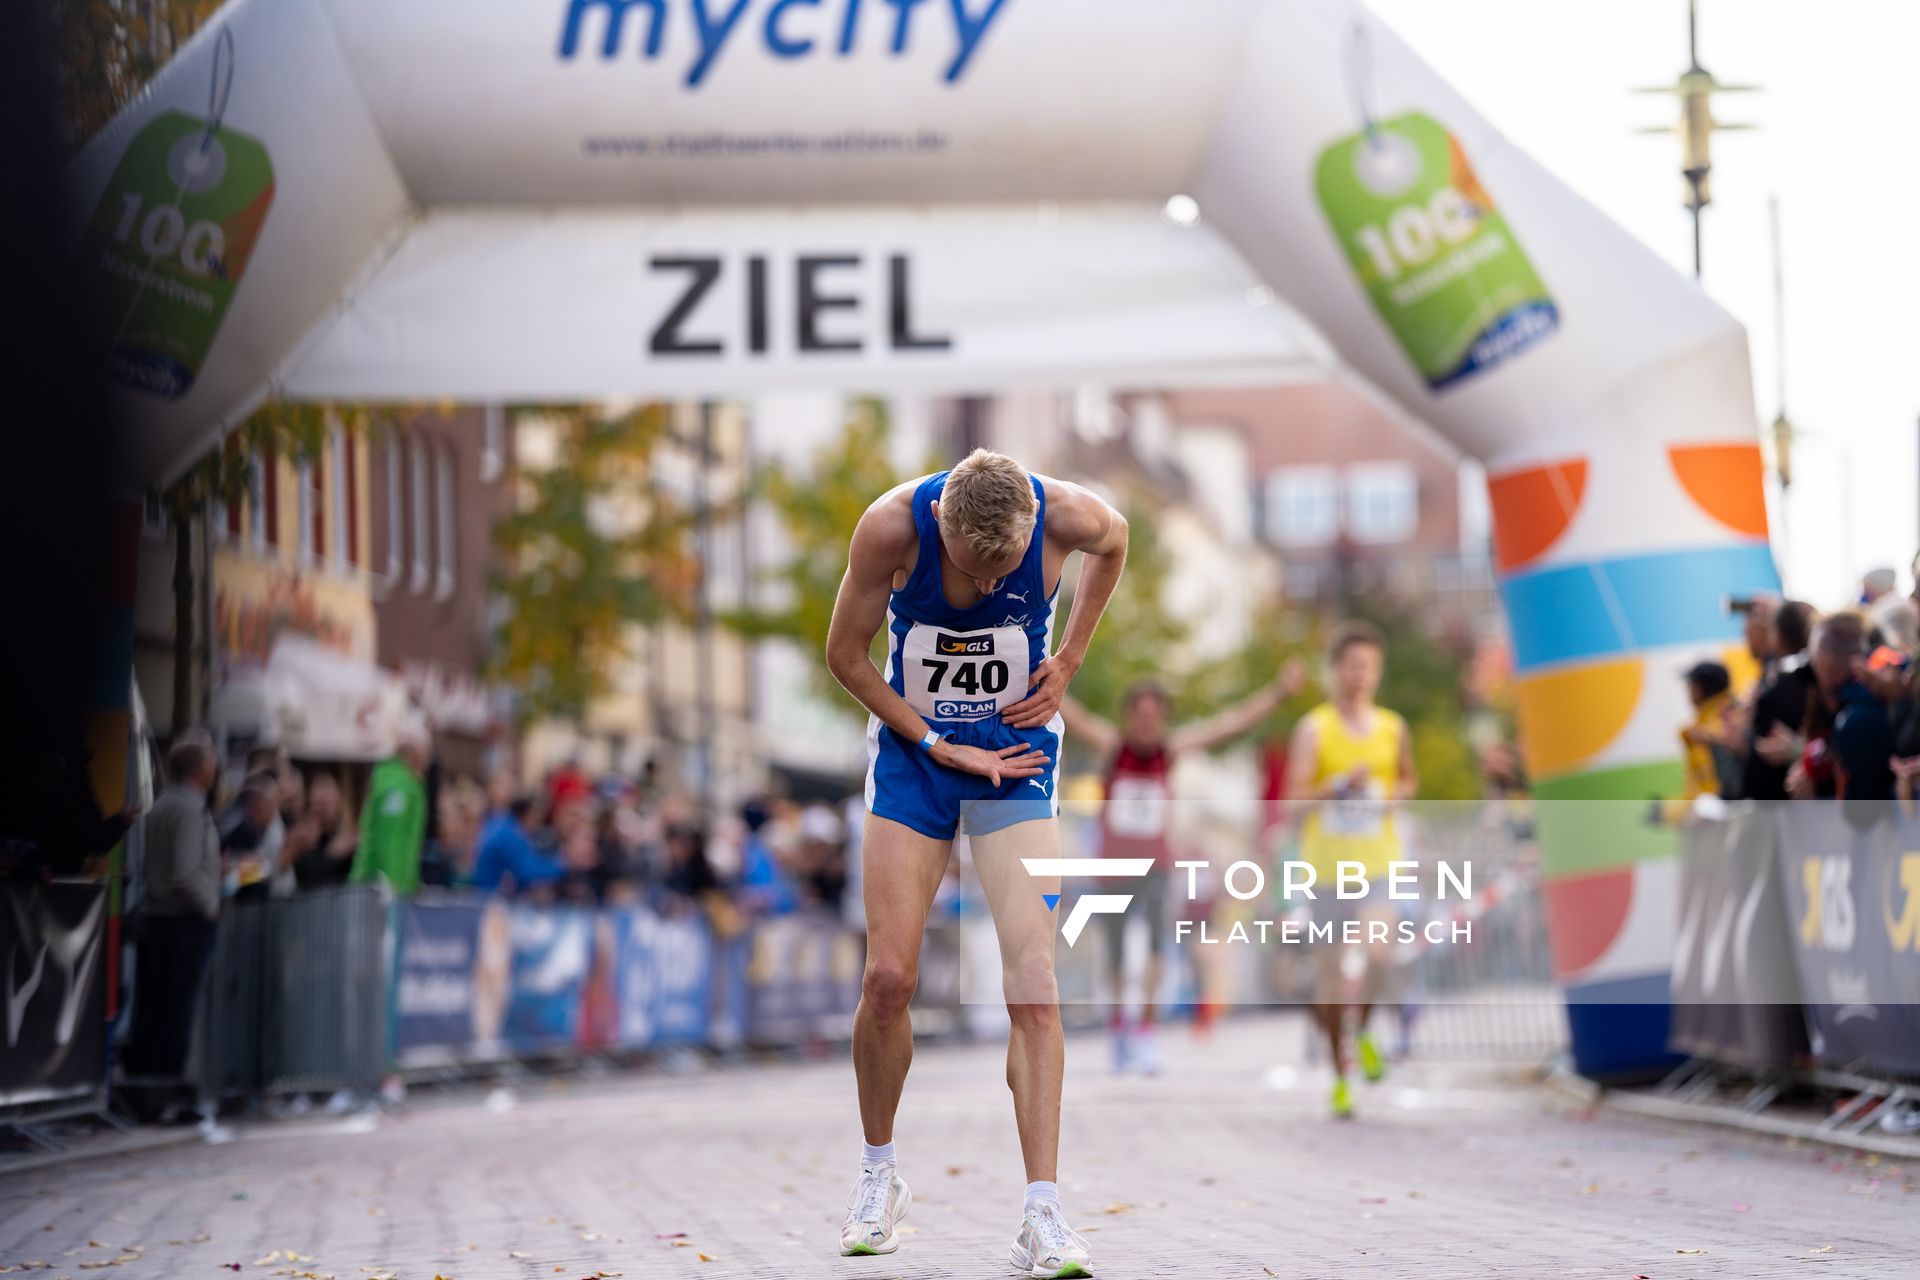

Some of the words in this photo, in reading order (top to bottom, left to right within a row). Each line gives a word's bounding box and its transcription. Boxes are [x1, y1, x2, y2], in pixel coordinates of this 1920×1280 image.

[647, 254, 954, 354] ZIEL
[966, 640, 990, 652] GLS
[921, 658, 1009, 696] 740
[960, 702, 994, 713] PLAN
